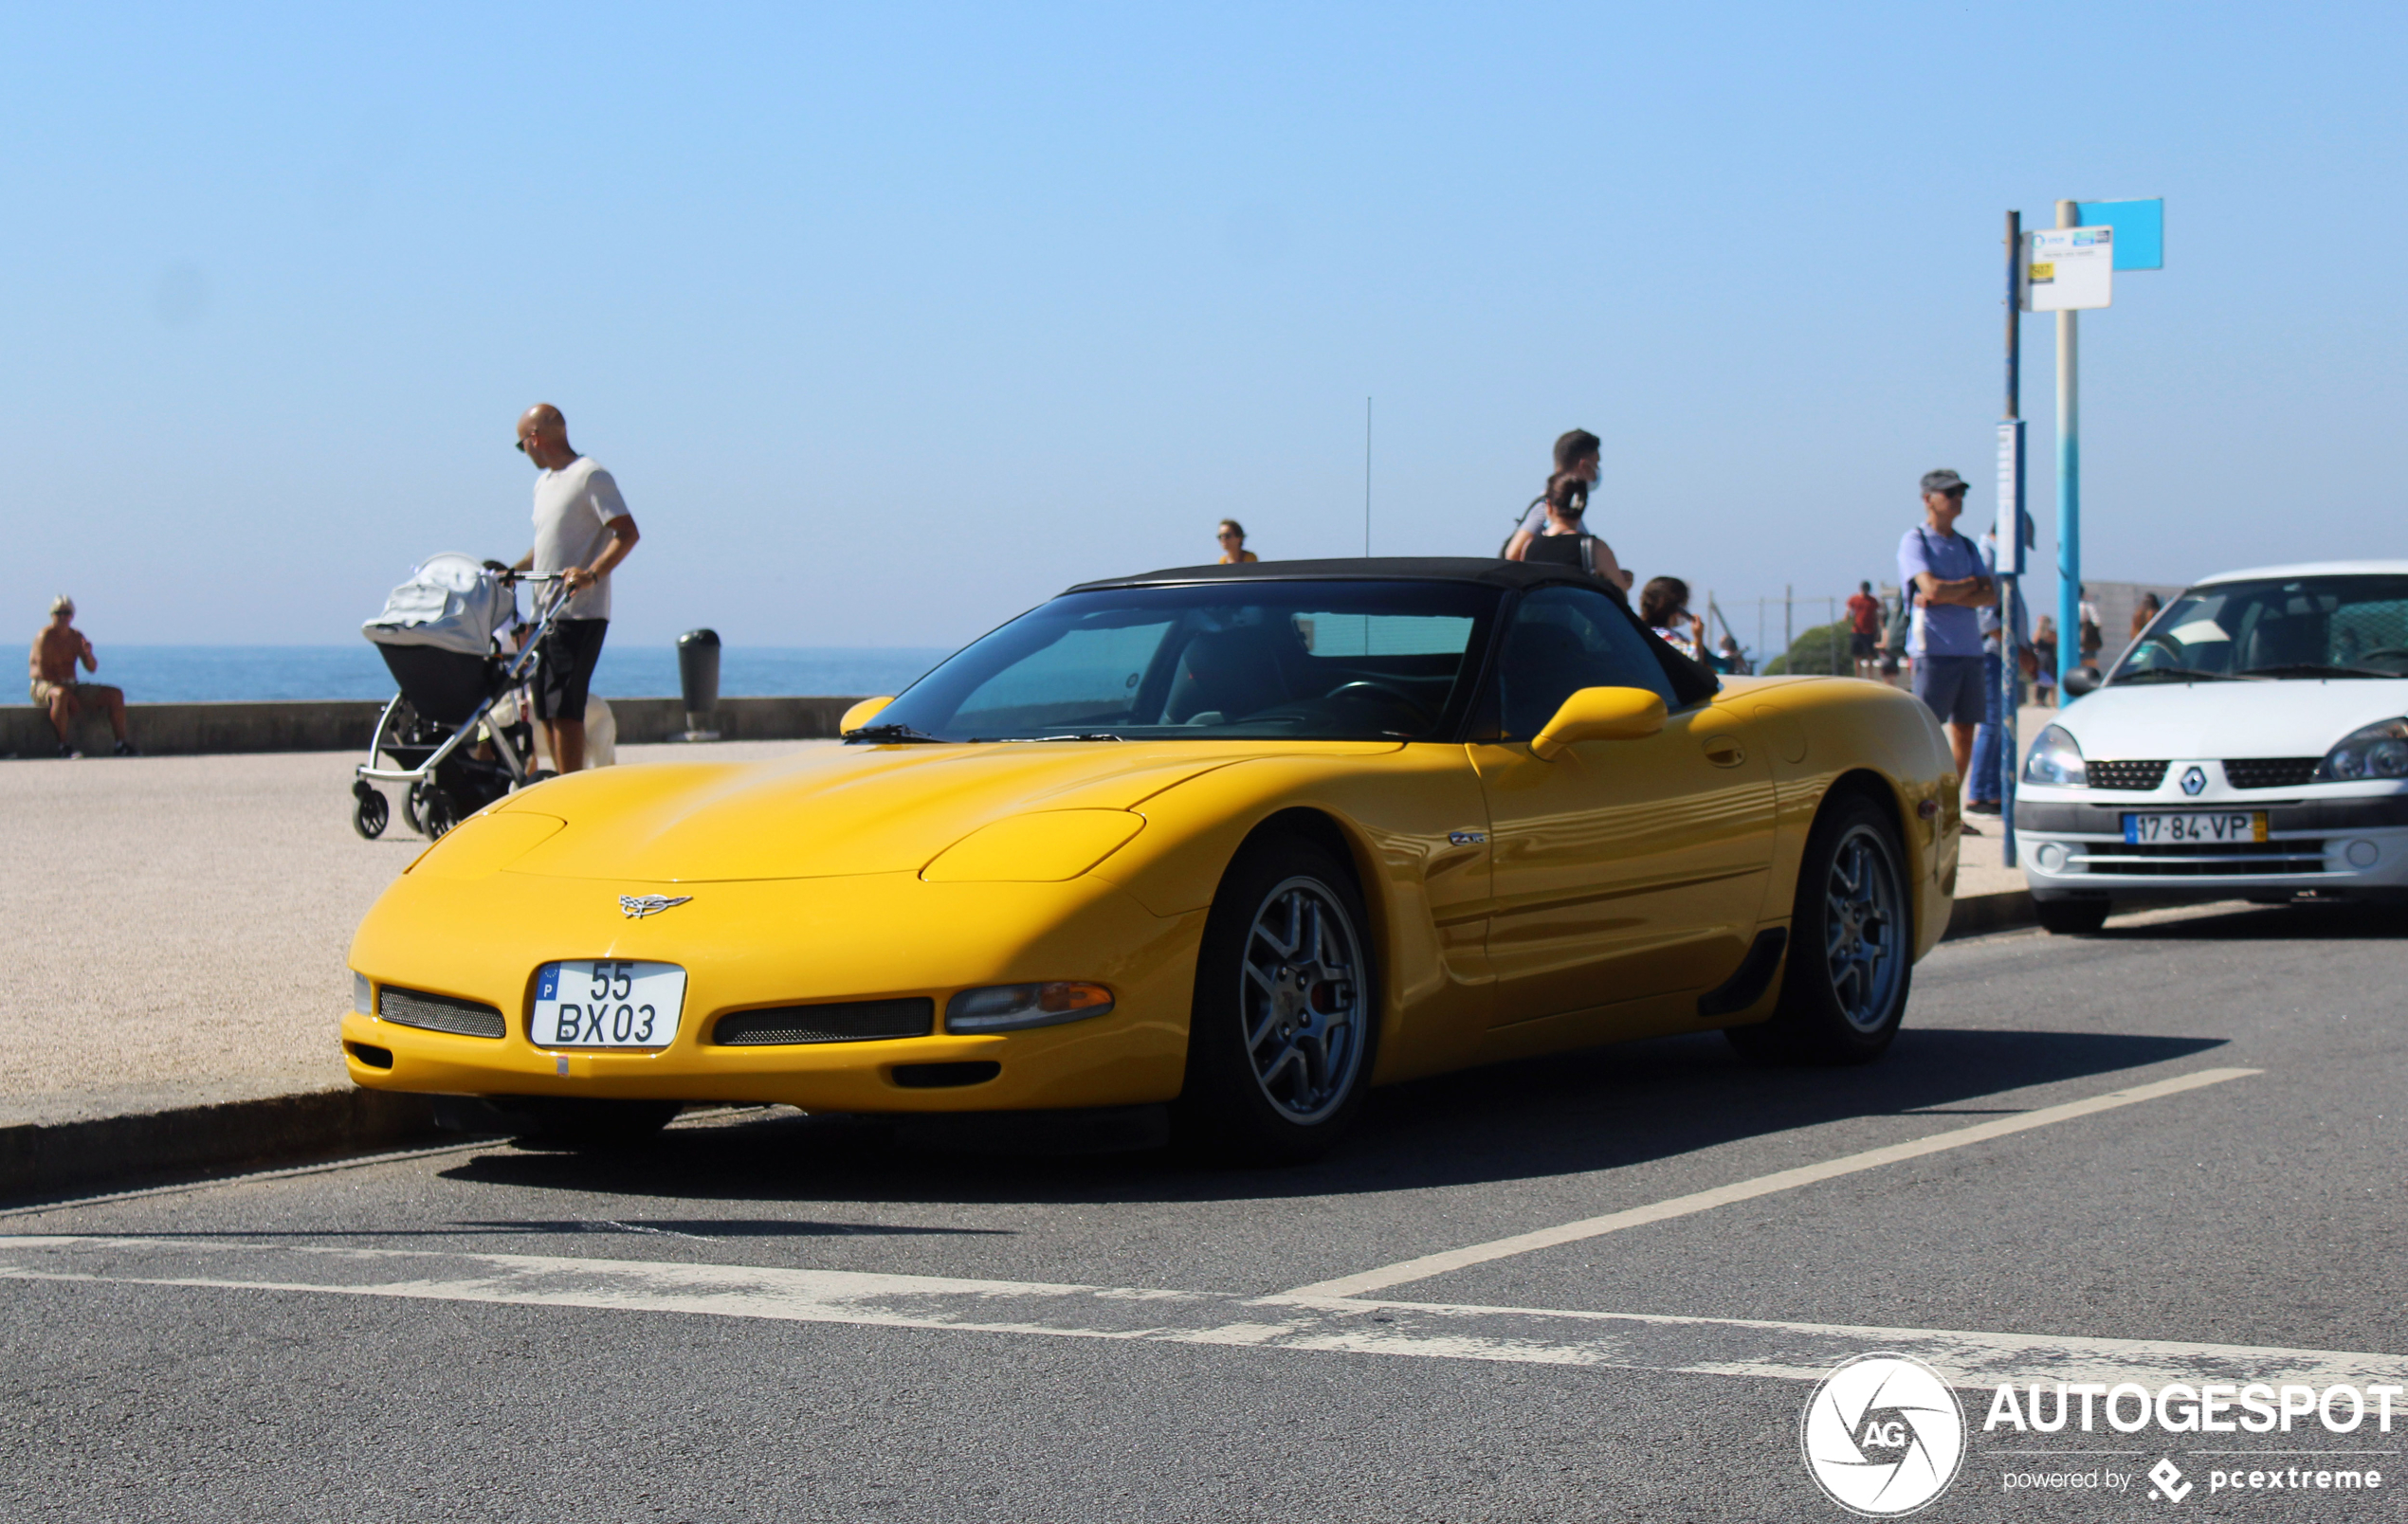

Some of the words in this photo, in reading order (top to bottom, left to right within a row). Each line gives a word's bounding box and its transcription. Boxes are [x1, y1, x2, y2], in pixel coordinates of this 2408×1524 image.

[543, 984, 553, 998] P
[590, 962, 634, 1001] 55
[556, 1004, 656, 1043] BX03
